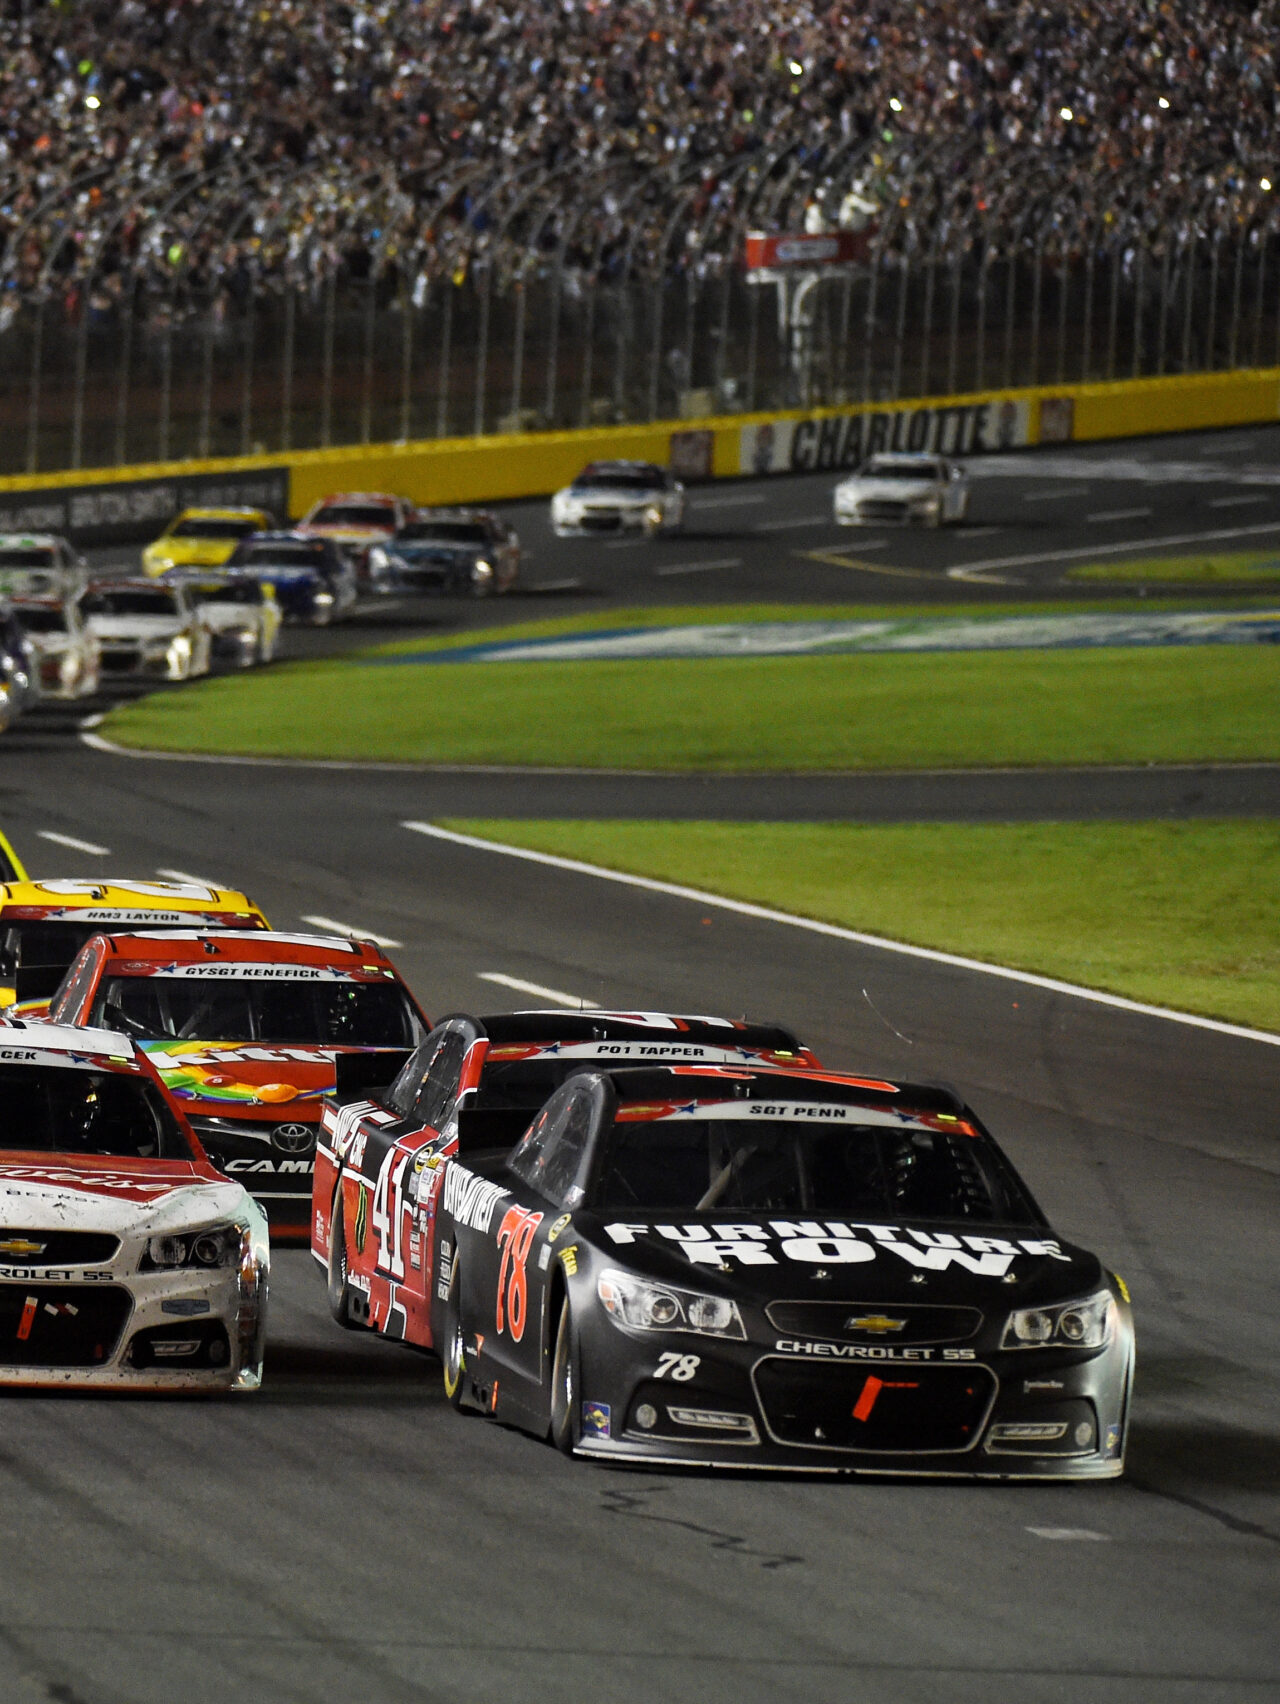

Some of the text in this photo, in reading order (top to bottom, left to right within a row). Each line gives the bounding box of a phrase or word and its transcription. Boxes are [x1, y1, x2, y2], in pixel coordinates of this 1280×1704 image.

[790, 404, 992, 469] CHARLOTTE
[87, 911, 180, 922] HM3 LAYTON
[185, 967, 321, 978] GYSGT KENEFICK
[638, 1045, 705, 1057] TAPPER
[749, 1104, 847, 1118] SGT PENN
[224, 1159, 315, 1174] CAM
[372, 1145, 409, 1285] 41
[604, 1221, 1072, 1262] FURNITURE
[678, 1238, 1017, 1277] ROW
[83, 1270, 115, 1281] SS
[496, 1203, 545, 1343] 78
[775, 1338, 977, 1360] CHEVROLET SS
[652, 1351, 701, 1382] 78
